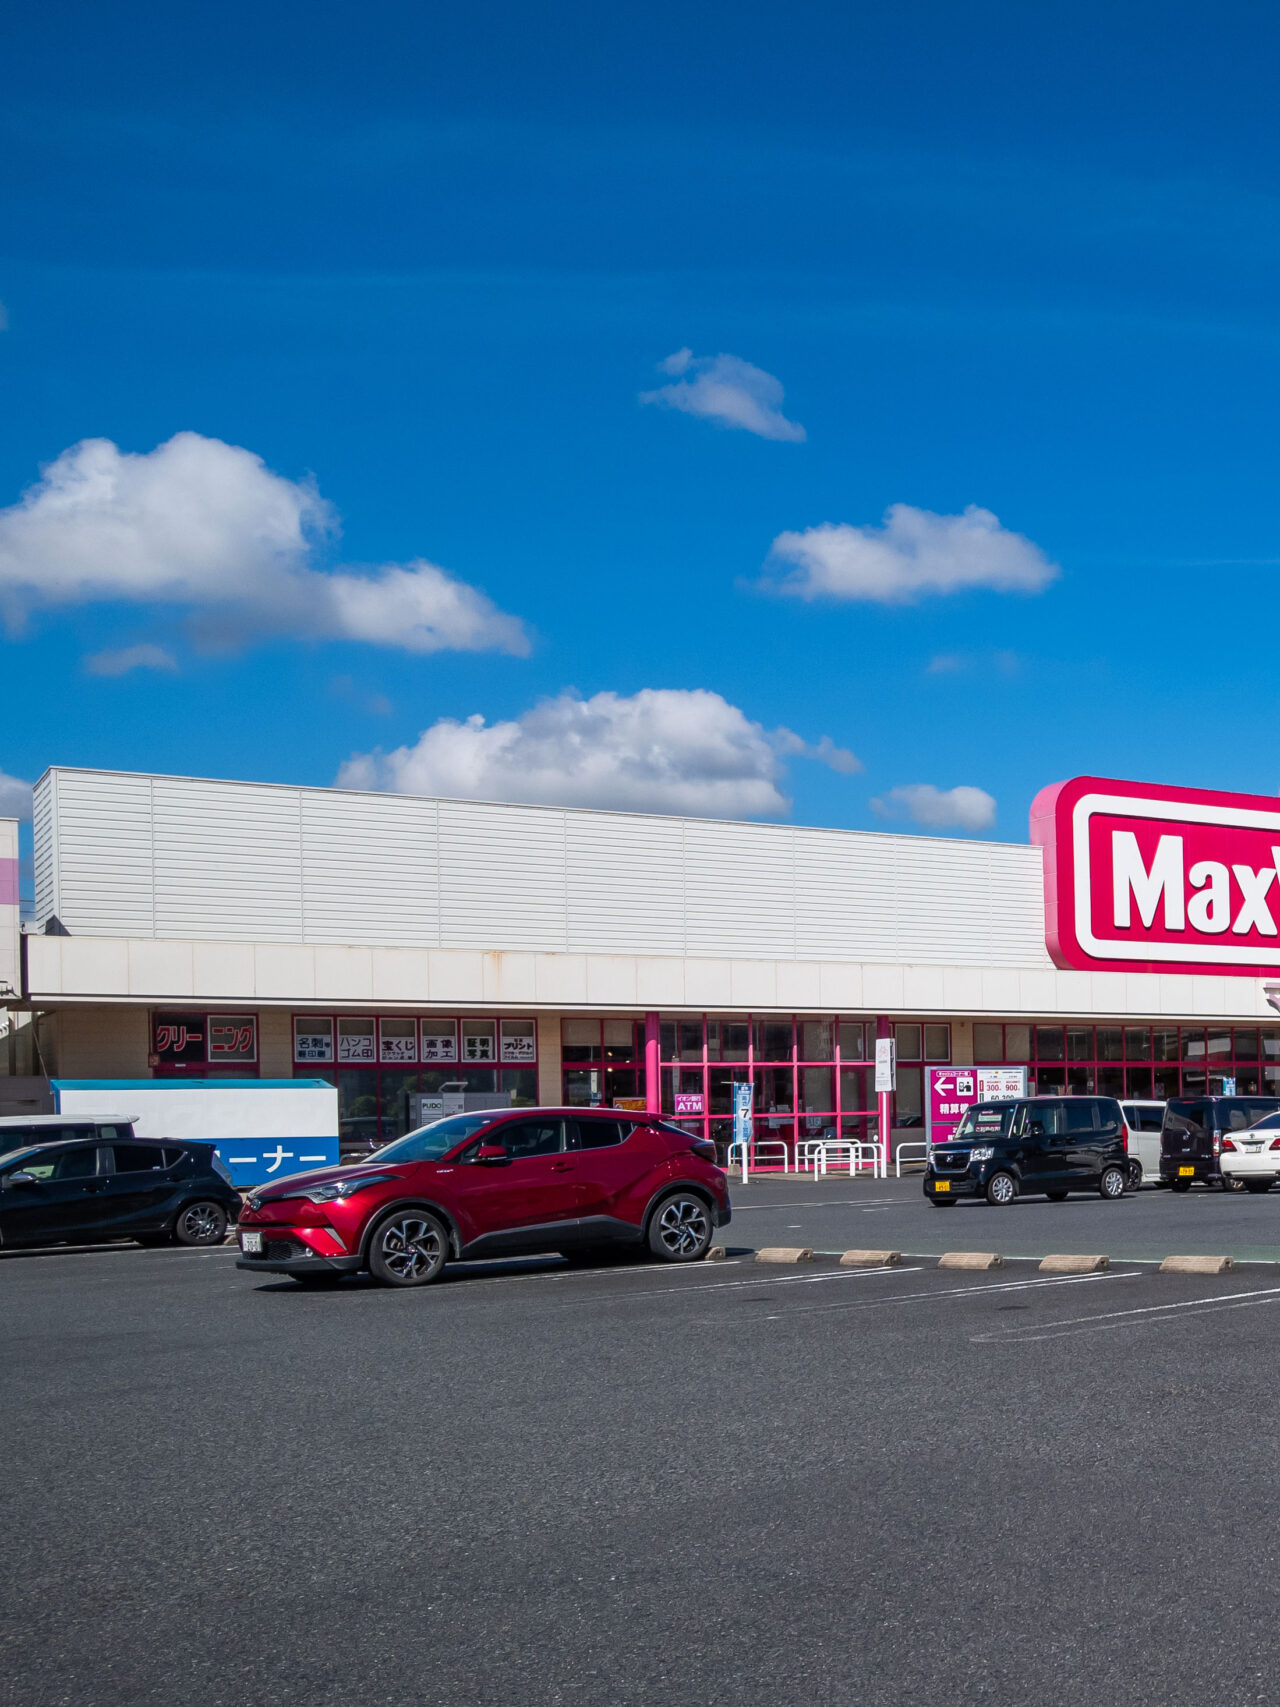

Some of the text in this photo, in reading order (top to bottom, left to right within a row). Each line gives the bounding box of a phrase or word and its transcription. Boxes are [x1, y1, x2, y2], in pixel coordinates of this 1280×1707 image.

[340, 1037, 372, 1048] ハンコ
[382, 1040, 415, 1052] 宝くじ
[425, 1039, 454, 1049] 画像
[467, 1038, 490, 1048] 証明
[503, 1042, 534, 1051] プリント
[341, 1048, 373, 1059] ゴム印
[425, 1049, 454, 1059] 加工
[467, 1048, 490, 1059] 写真
[677, 1102, 702, 1111] ATM
